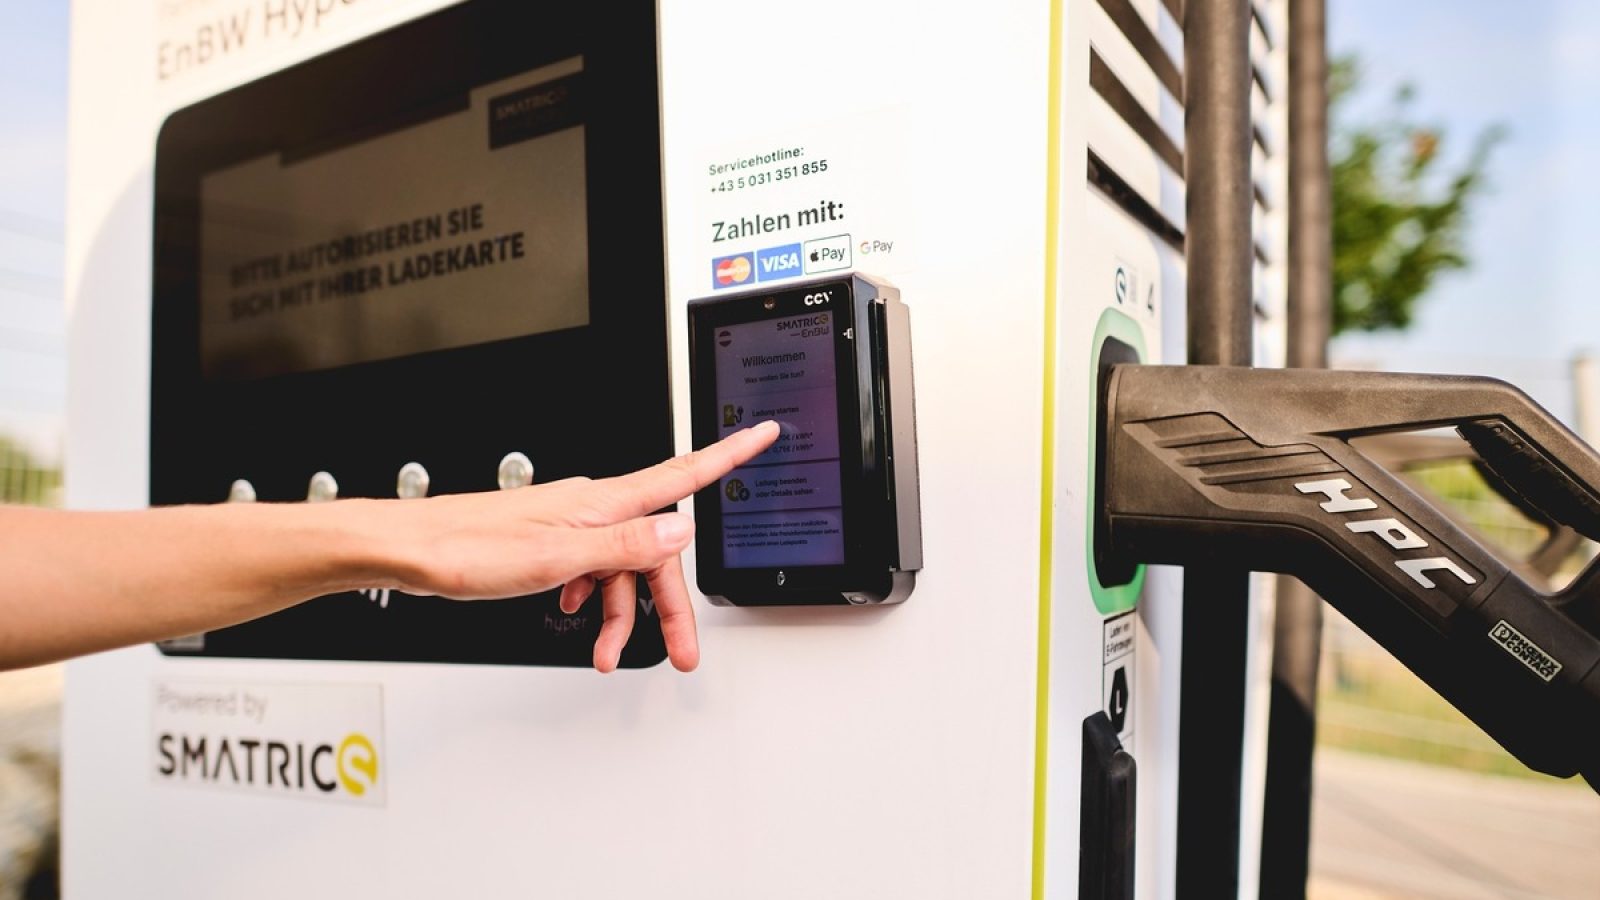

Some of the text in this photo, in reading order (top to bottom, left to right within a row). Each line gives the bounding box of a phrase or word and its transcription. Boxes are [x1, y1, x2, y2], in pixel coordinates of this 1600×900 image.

[157, 0, 351, 80] EnBW Hyp
[708, 147, 804, 176] Servicehotline:
[737, 177, 745, 189] 5
[748, 171, 771, 187] 031
[775, 166, 798, 181] 351
[801, 159, 828, 175] 855
[711, 200, 845, 243] Zahlen mit:
[230, 204, 484, 289] BITTE AUTORISIEREN SIE
[821, 247, 846, 262] Pay
[873, 240, 893, 254] Pay
[229, 232, 525, 322] SICH MIT IHRER LADEKARTE
[760, 252, 801, 274] VISA
[804, 291, 833, 306] CCV
[742, 351, 806, 368] Willkommen
[755, 478, 778, 488] Ladung
[1294, 478, 1477, 589] HPC
[544, 612, 587, 638] hyper
[1506, 640, 1555, 678] CONTACT
[158, 681, 268, 725] Powered by
